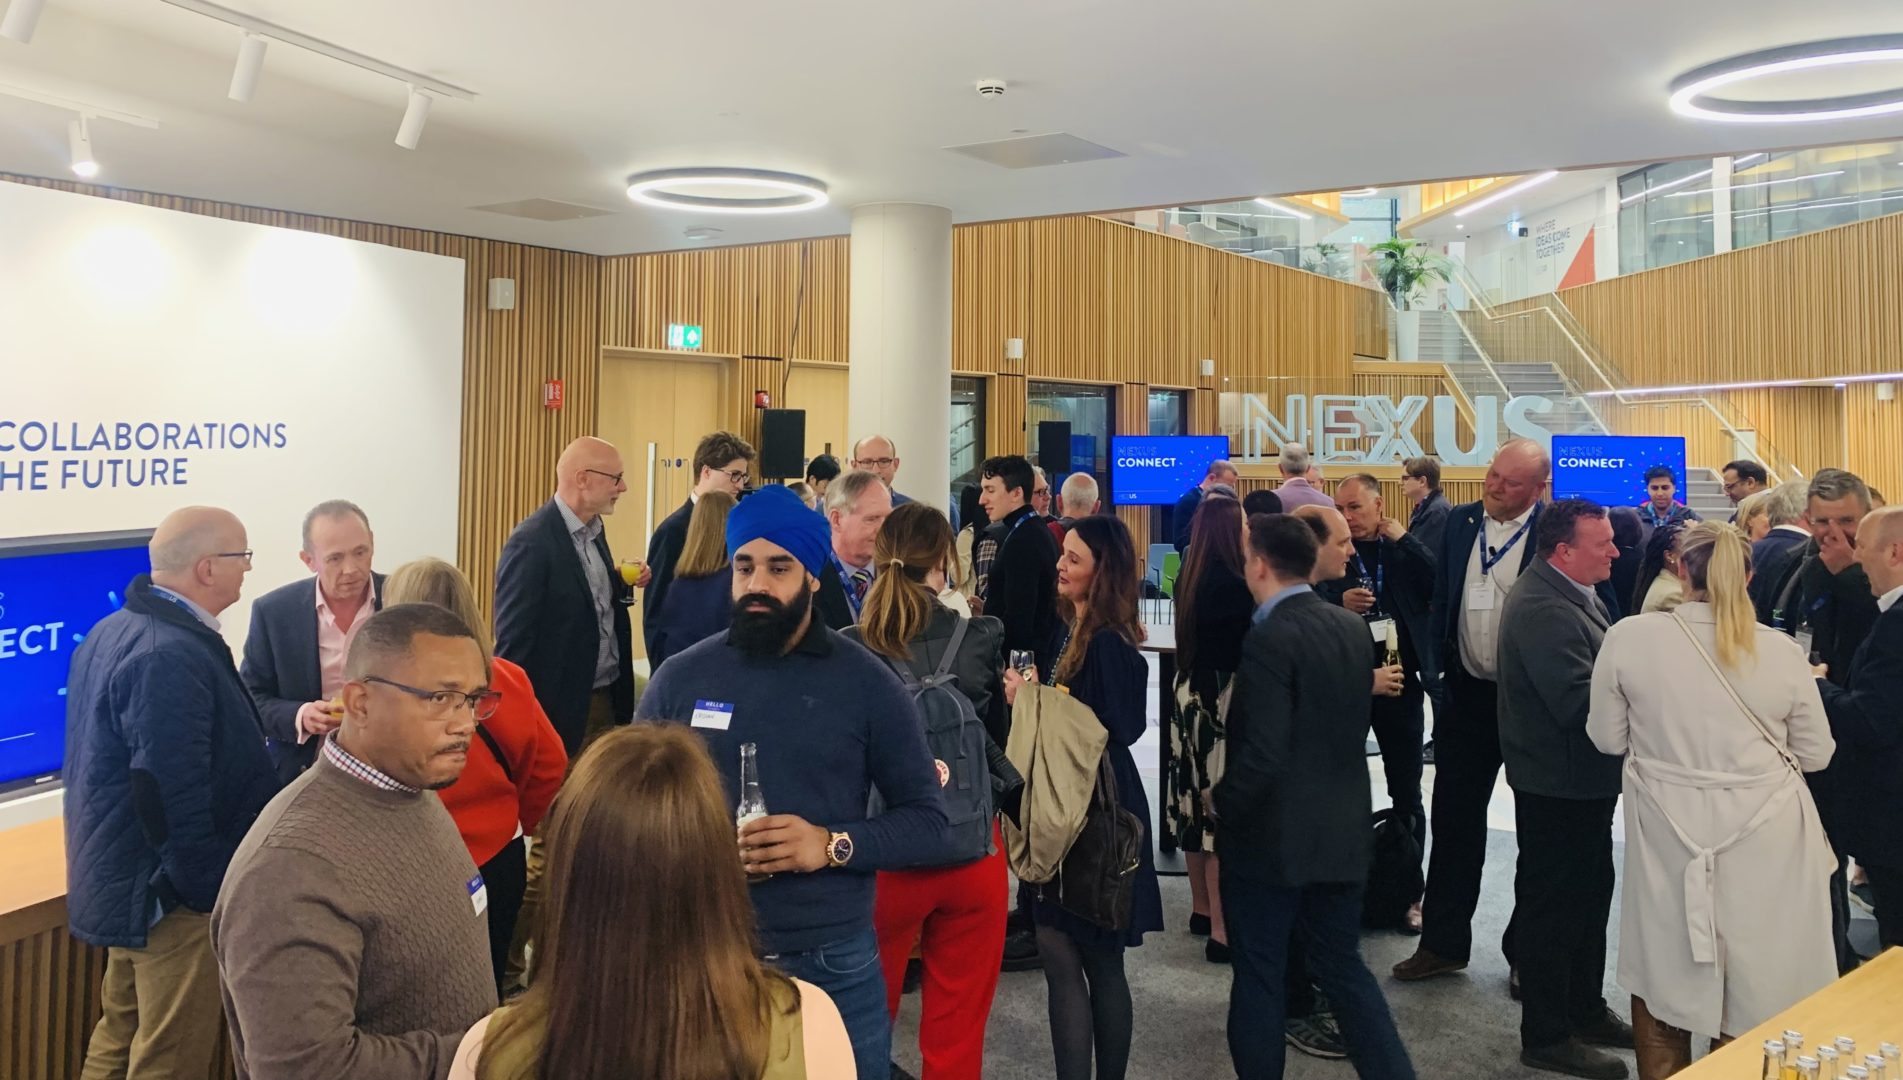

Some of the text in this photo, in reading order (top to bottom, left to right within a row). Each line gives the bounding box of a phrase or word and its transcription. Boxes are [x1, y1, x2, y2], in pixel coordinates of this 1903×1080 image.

[1536, 219, 1556, 234] WHERE
[1243, 394, 1554, 465] NEXUS
[0, 421, 287, 452] COLLABORATIONS
[1117, 446, 1157, 456] NEXUS
[1559, 446, 1603, 456] NEXUS
[1117, 457, 1176, 468] CONNECT
[1558, 458, 1625, 468] CONNECT
[61, 458, 188, 489] FUTURE
